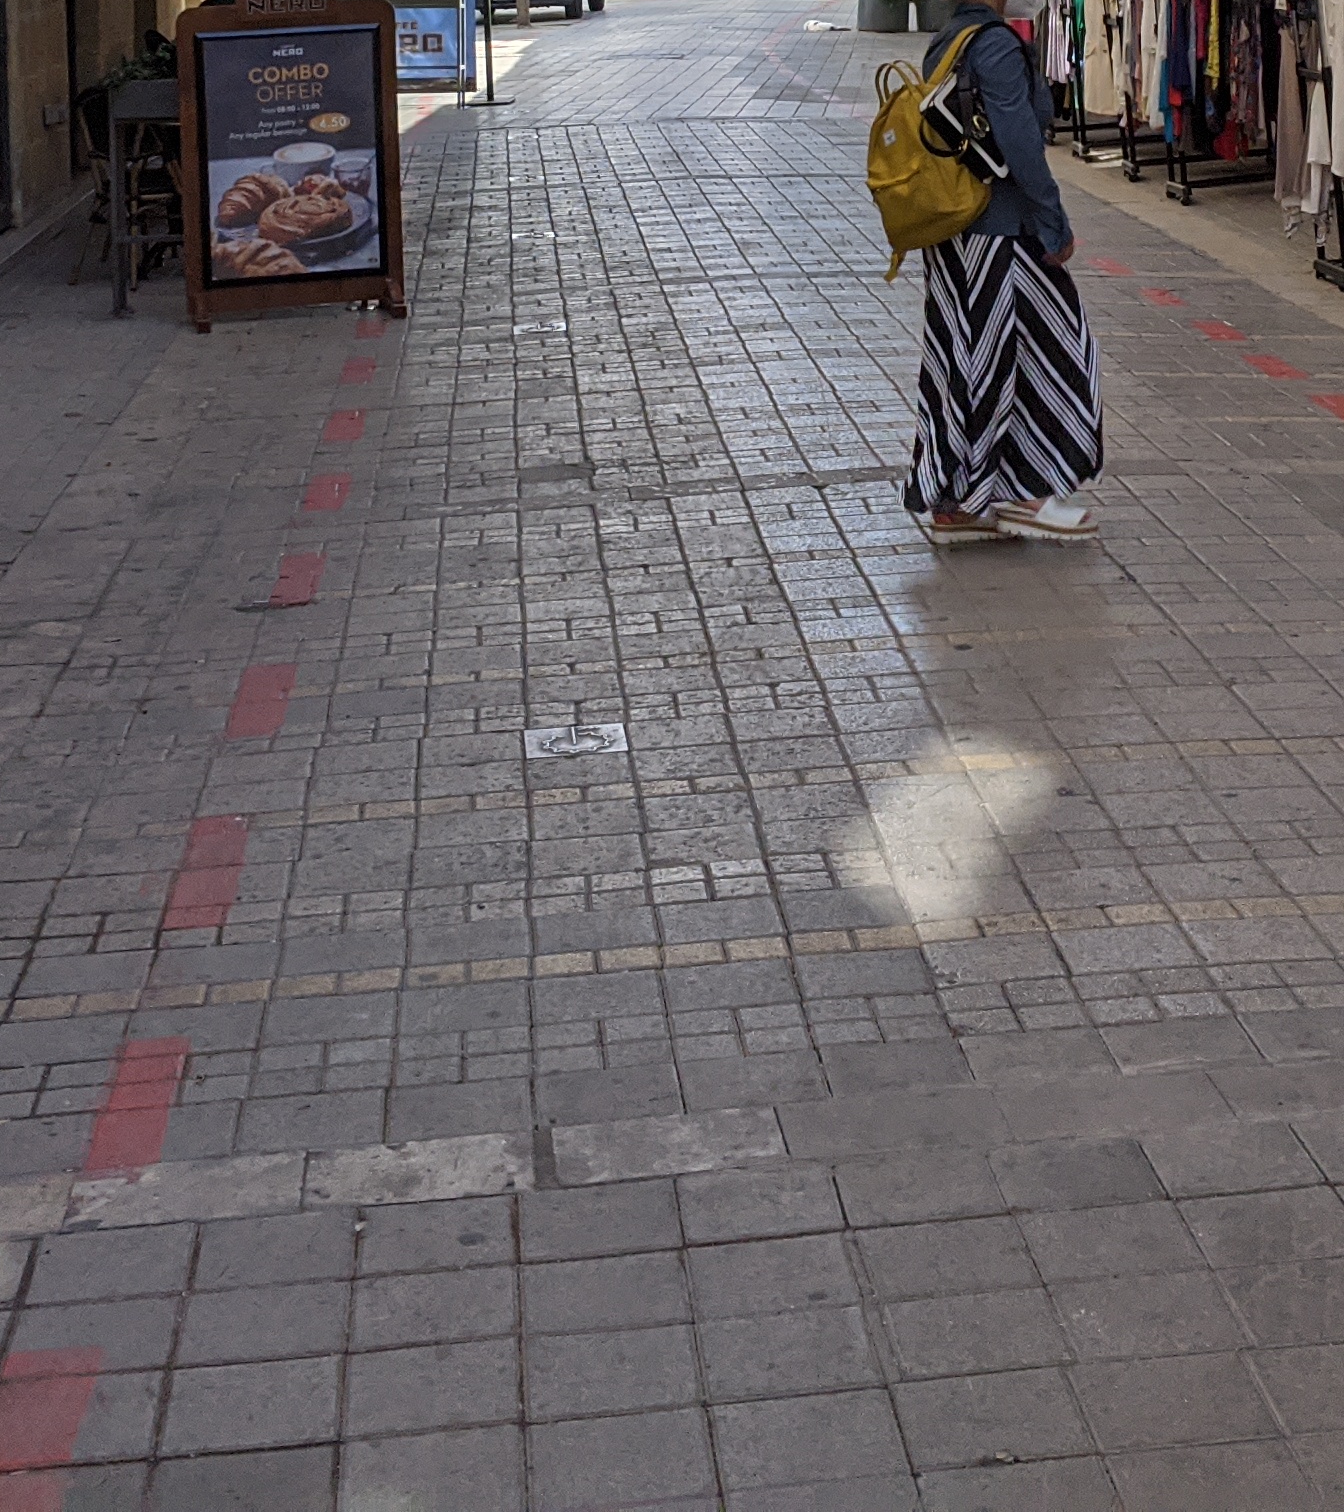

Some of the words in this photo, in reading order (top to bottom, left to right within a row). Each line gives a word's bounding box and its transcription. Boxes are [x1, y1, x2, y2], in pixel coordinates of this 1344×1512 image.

[272, 47, 304, 57] NERO
[398, 33, 443, 53] RO
[248, 62, 329, 84] COMBO
[256, 82, 324, 103] OFFER
